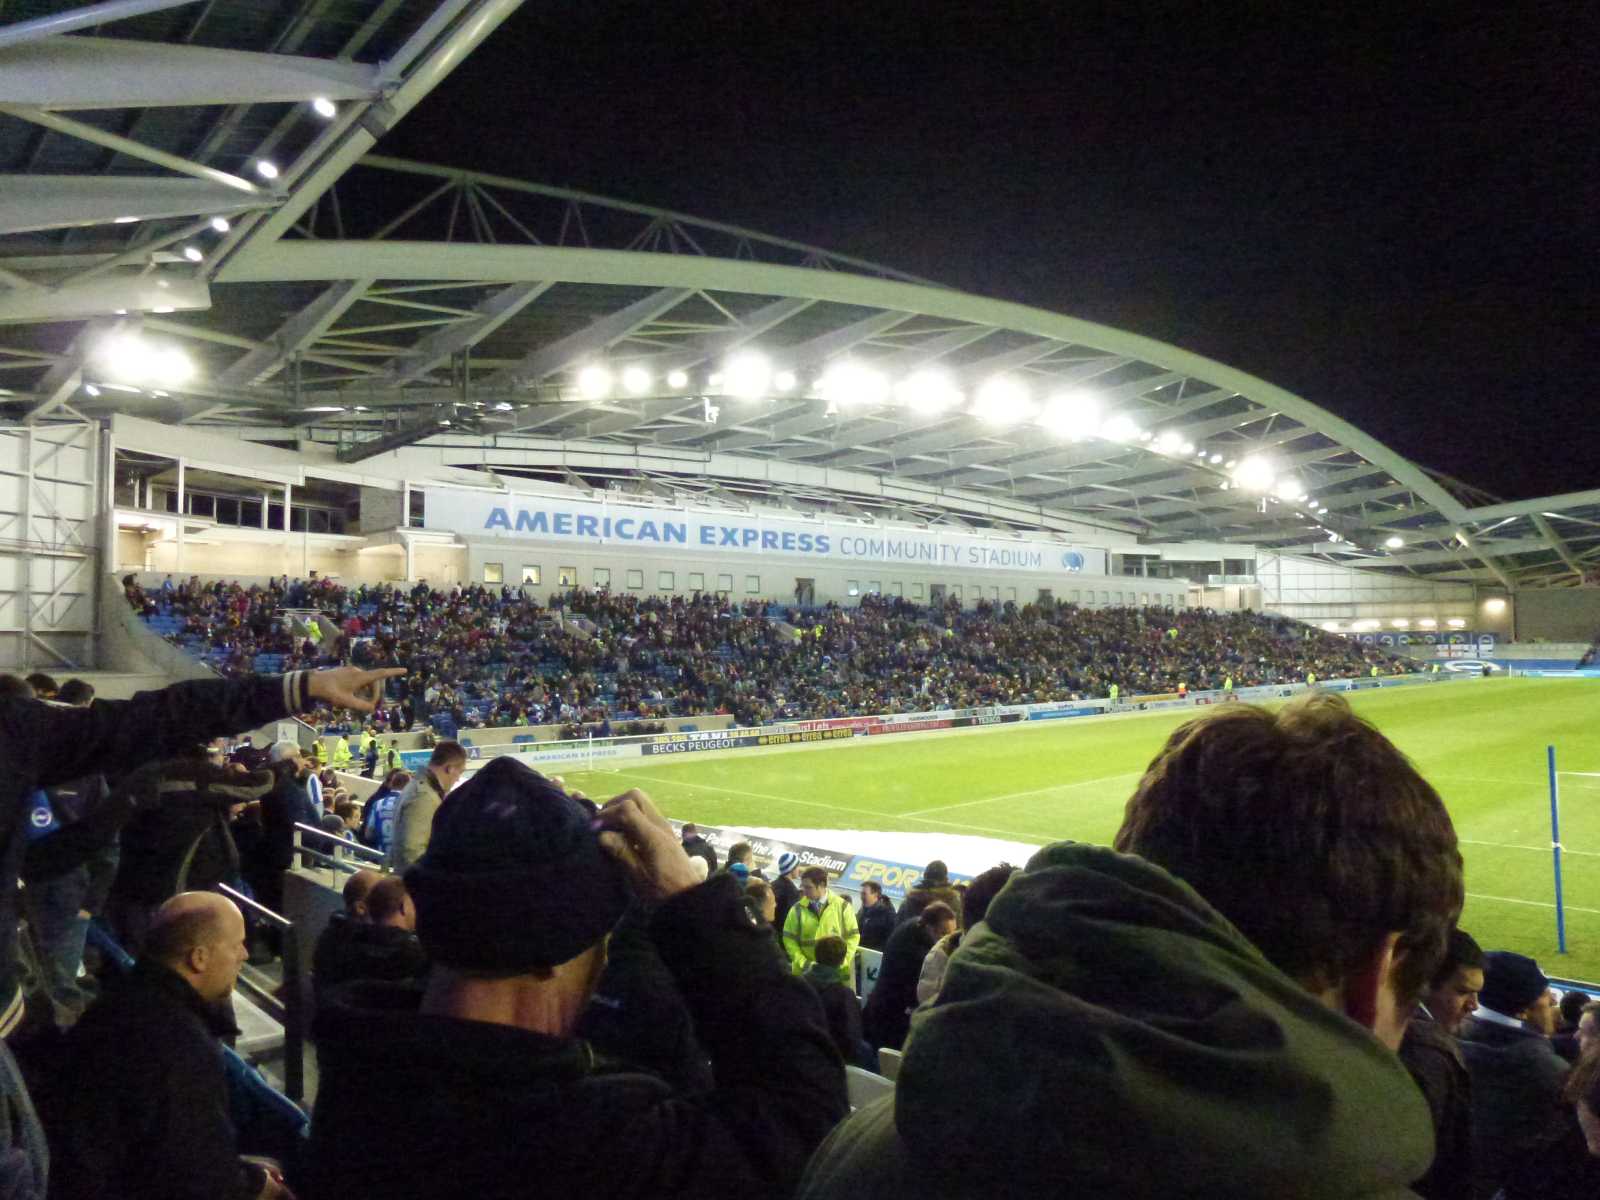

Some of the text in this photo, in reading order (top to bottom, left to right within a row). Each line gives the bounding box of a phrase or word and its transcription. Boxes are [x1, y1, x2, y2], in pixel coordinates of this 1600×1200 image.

[484, 506, 1042, 568] AMERICAN EXPRESS COMMUNITY STADIUM
[652, 742, 686, 754] BECKS
[688, 738, 736, 752] PEUGEOT
[800, 851, 847, 872] Stadium
[849, 859, 924, 889] SPOR
